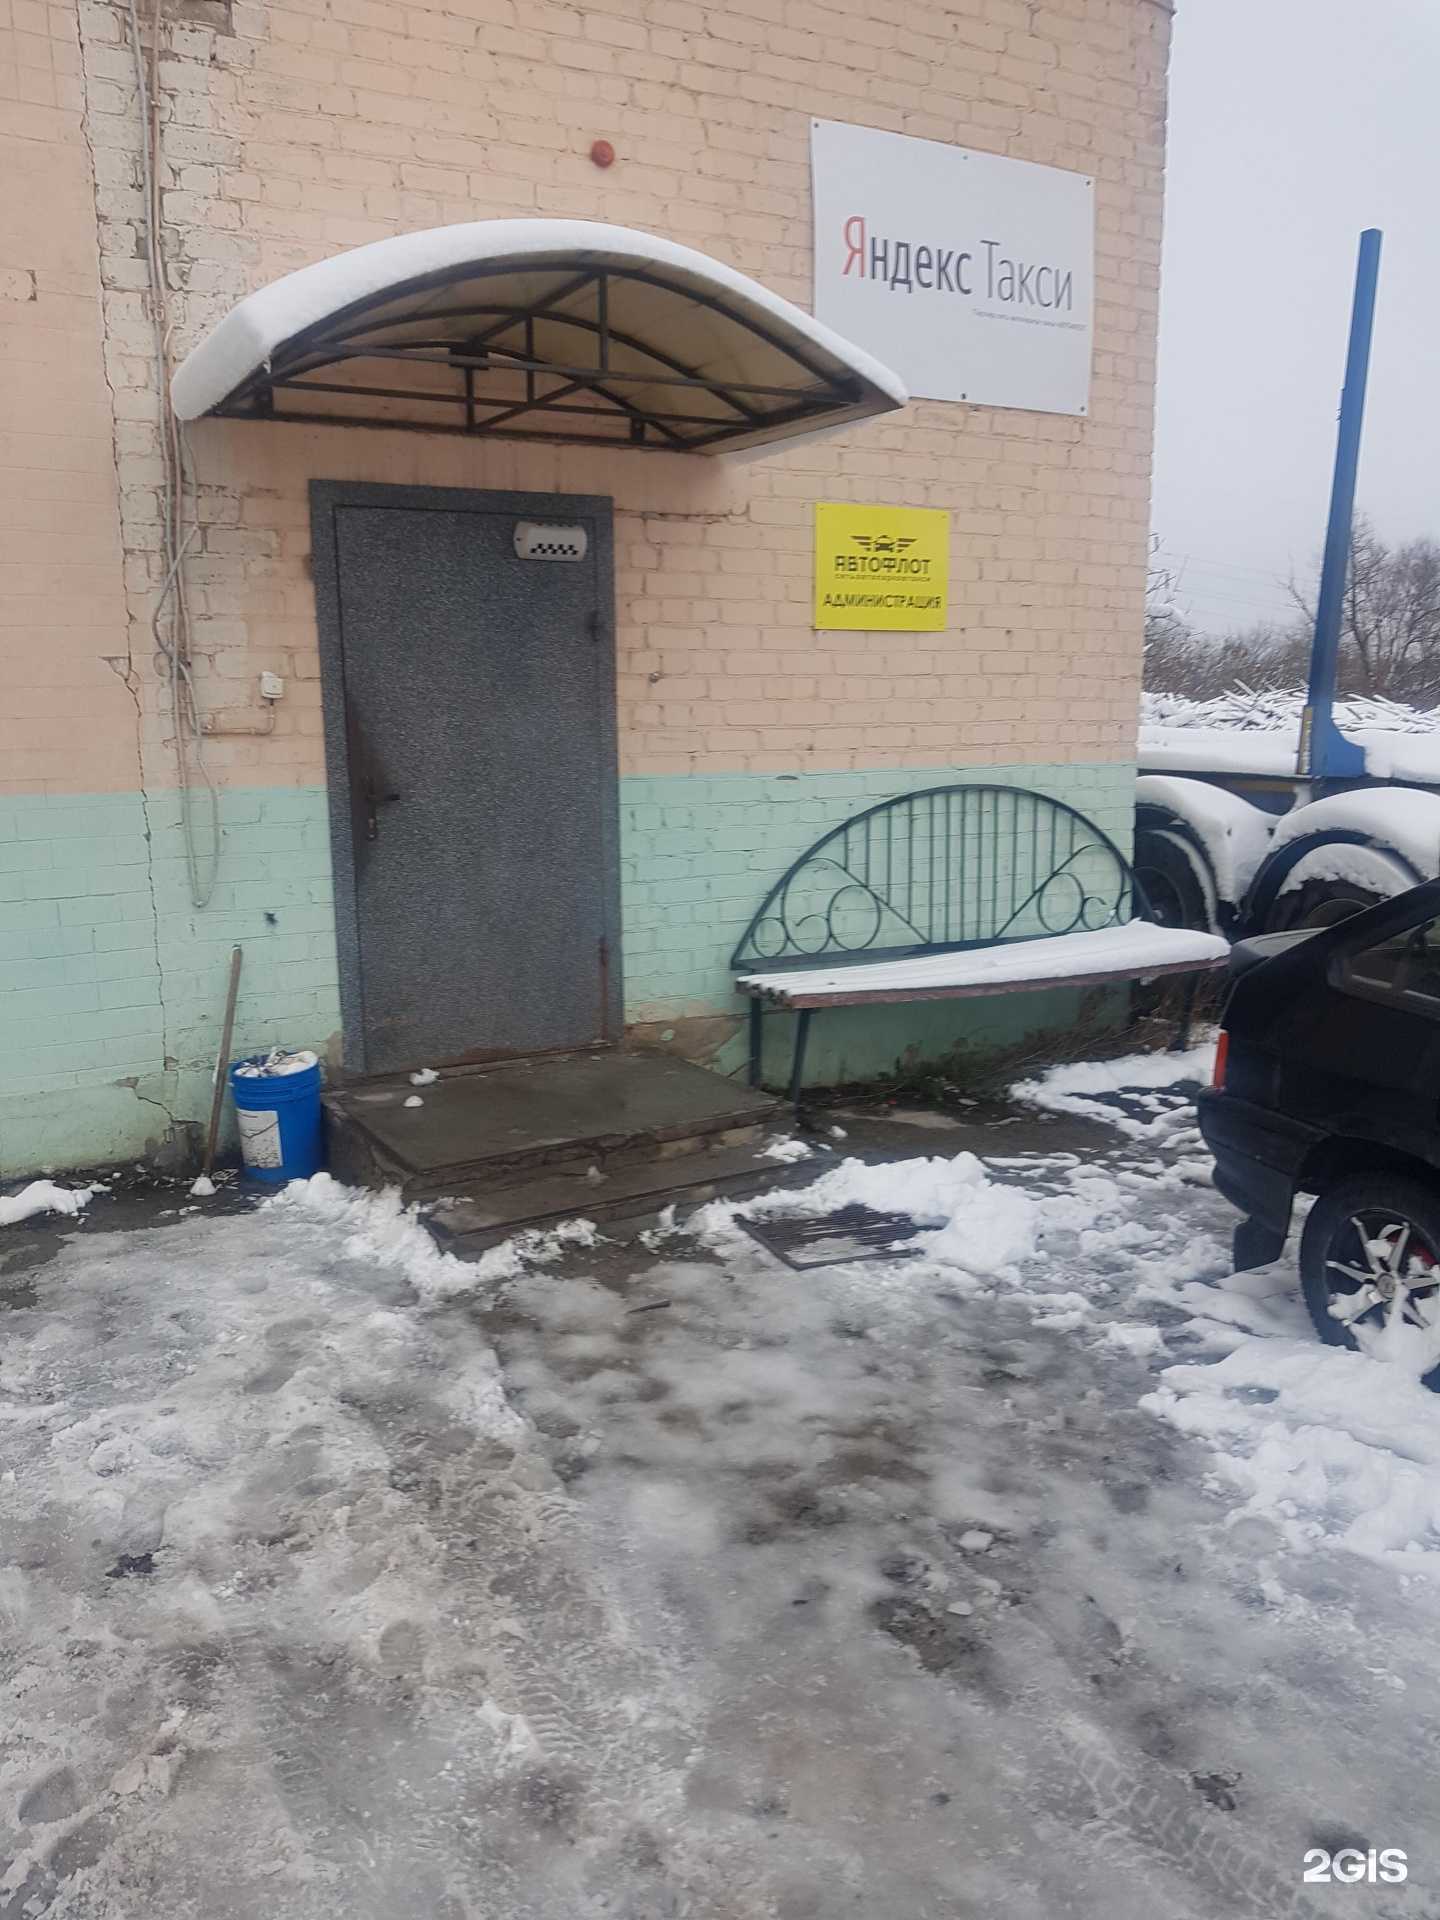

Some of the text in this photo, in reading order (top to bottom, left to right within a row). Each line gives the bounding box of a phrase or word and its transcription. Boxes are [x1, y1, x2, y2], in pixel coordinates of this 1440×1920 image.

[842, 216, 1072, 310] Яндекс Такси
[824, 594, 941, 609] АДМИНИСТРАЦИЯ
